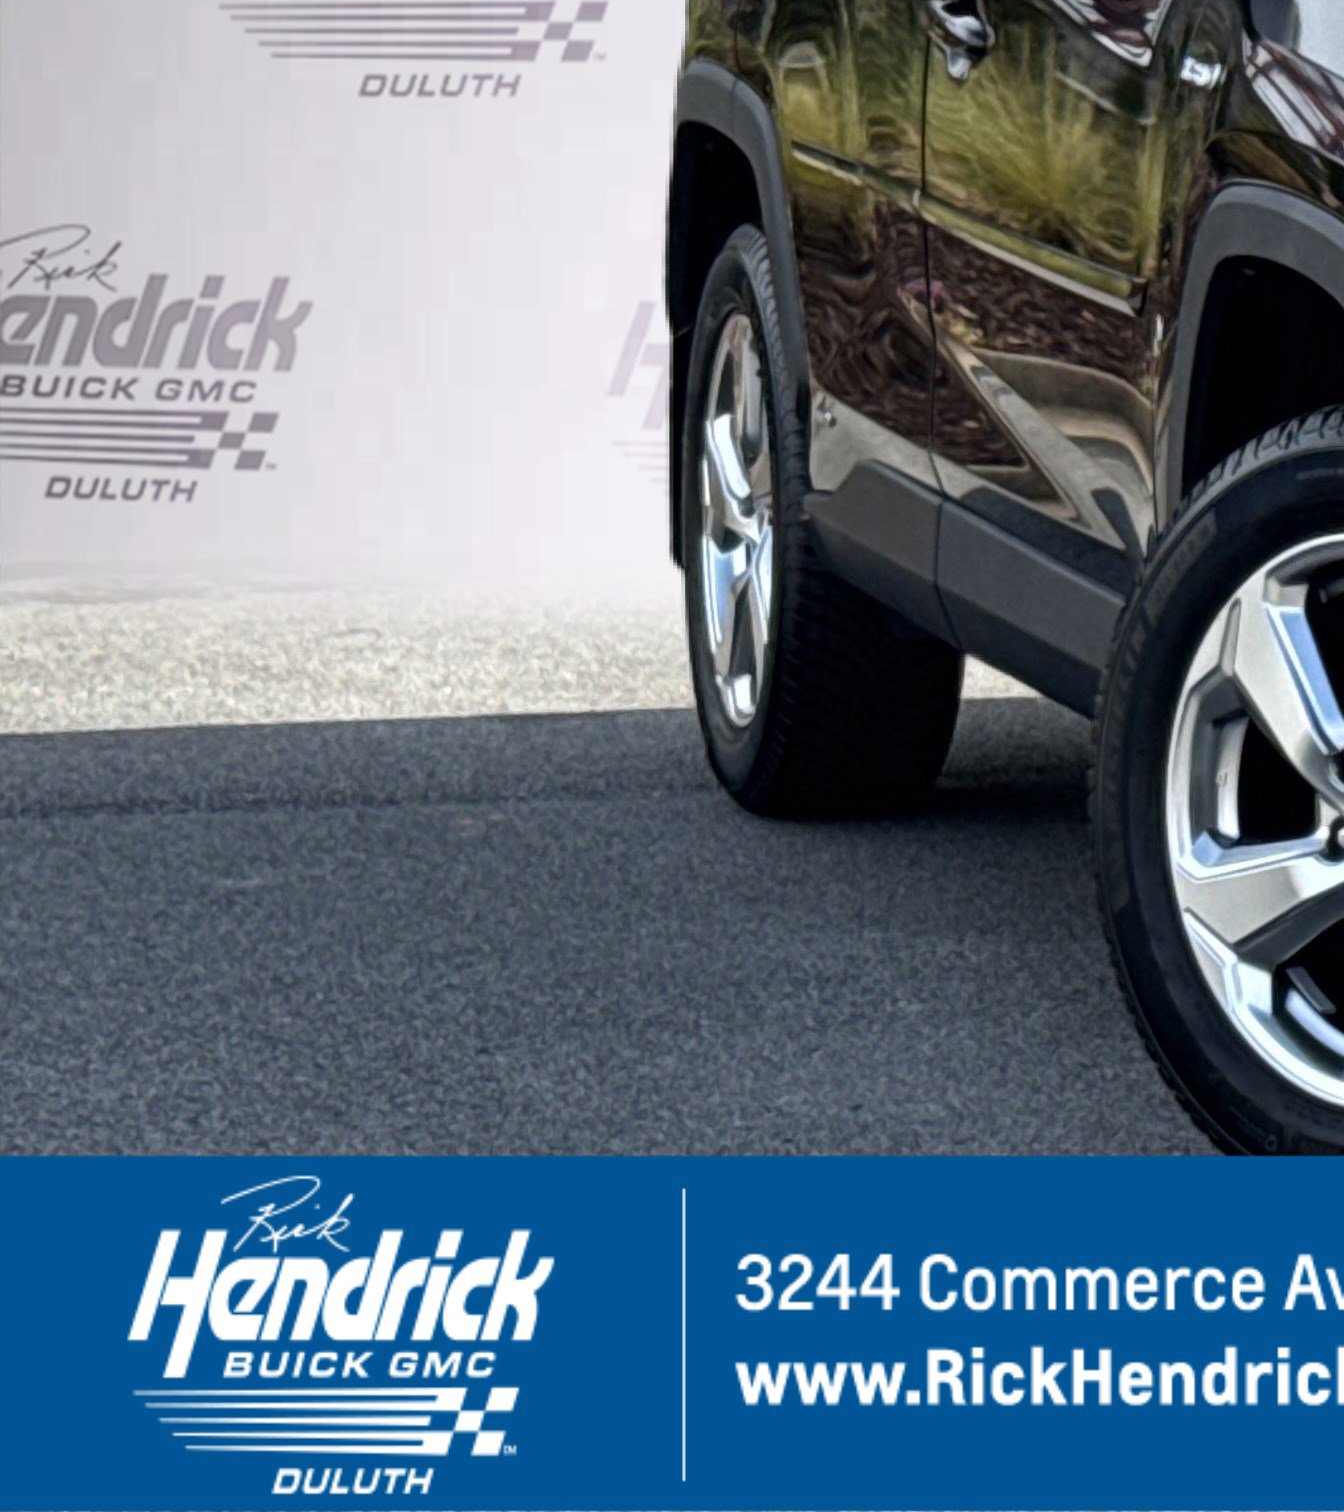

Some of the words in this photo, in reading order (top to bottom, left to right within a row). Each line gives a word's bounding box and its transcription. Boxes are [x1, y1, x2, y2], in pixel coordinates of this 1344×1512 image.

[357, 74, 522, 98] DULUTH
[0, 273, 314, 372] endrick
[0, 374, 139, 400] BUICK
[155, 378, 258, 404] GMC
[44, 476, 198, 503] DULUTH
